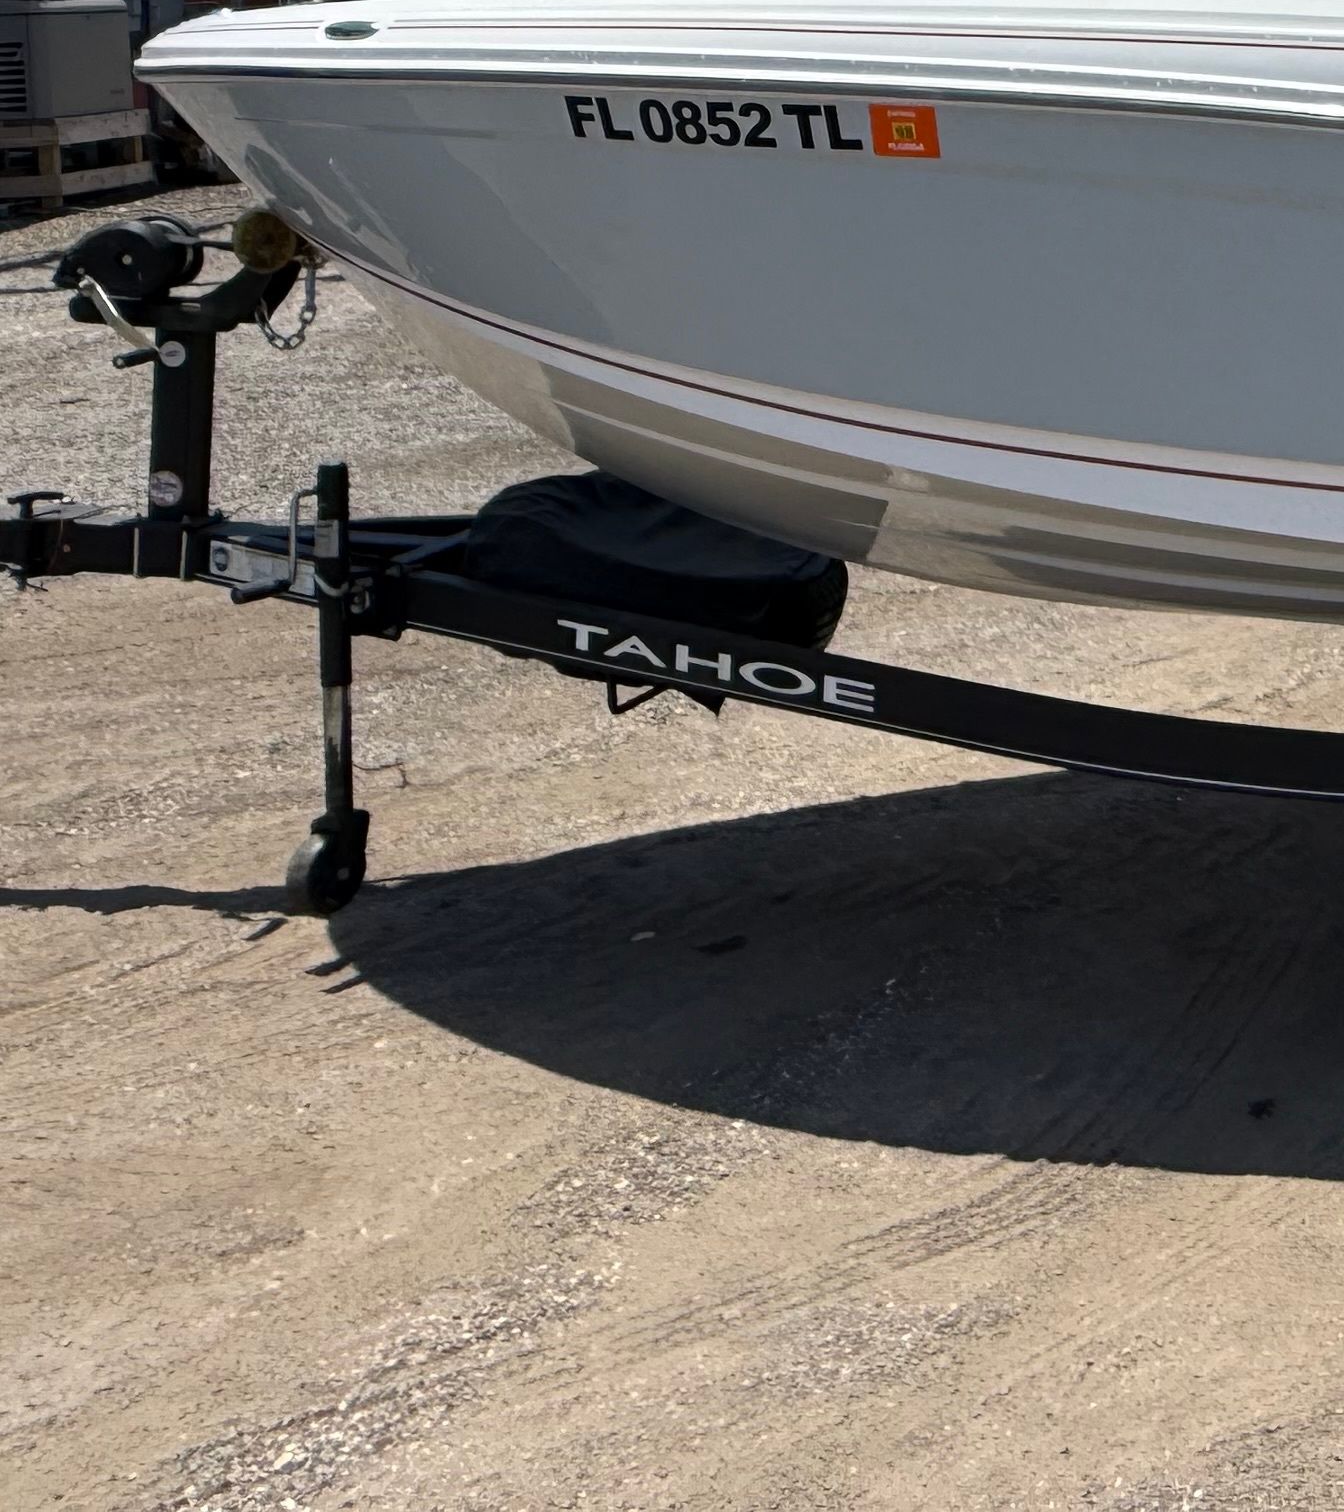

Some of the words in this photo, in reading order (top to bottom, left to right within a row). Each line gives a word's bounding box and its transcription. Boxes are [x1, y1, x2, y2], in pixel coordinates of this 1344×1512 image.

[564, 95, 634, 141] FL
[638, 98, 778, 149] 0852
[781, 103, 864, 151] TL
[557, 619, 876, 713] TAHOE
